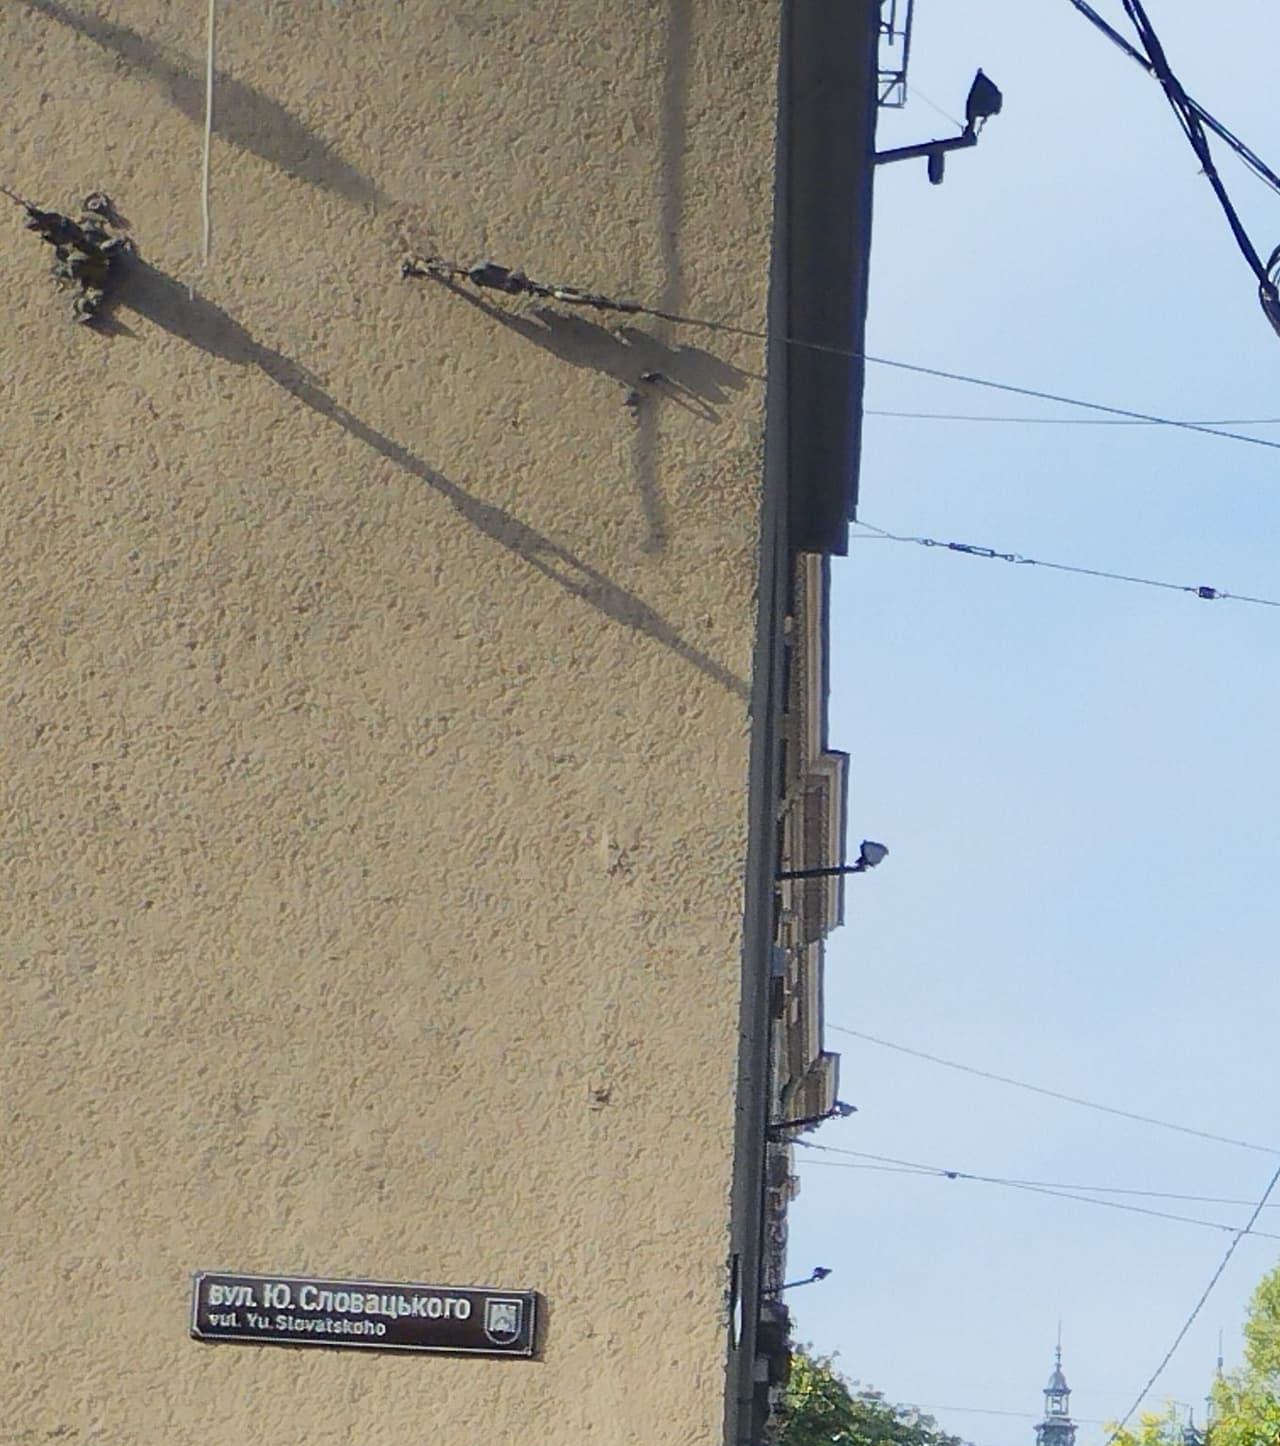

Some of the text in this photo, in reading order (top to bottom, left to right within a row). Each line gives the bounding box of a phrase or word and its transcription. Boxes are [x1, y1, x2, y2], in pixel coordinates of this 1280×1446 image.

[264, 1283, 296, 1310] Ю.
[300, 1285, 471, 1320] Словацького
[276, 1315, 387, 1336] Slovatskoho
